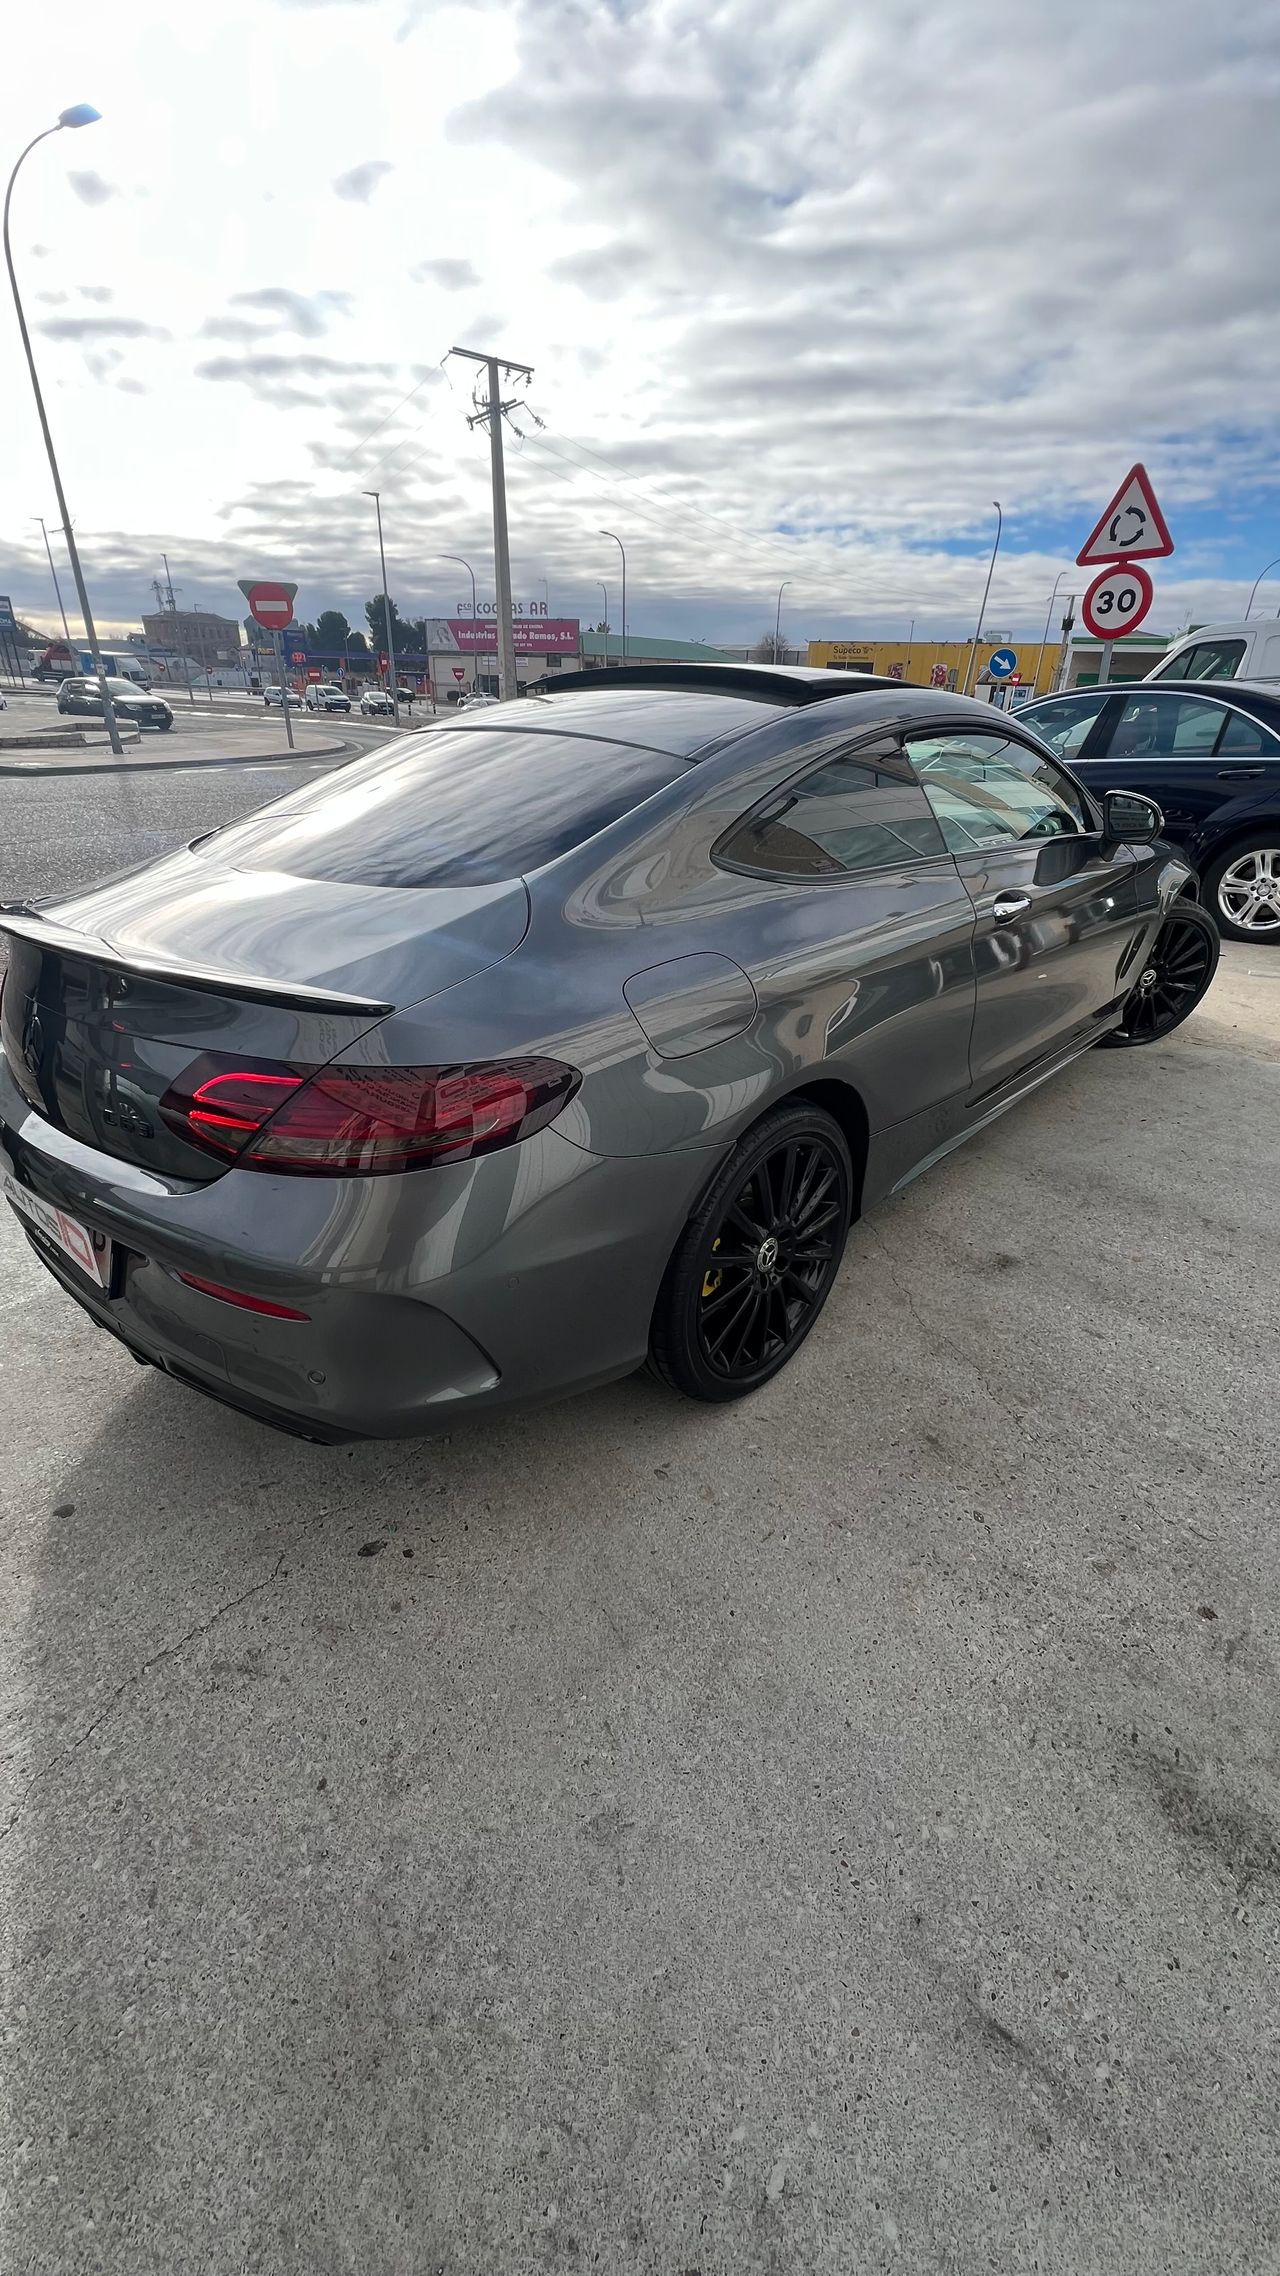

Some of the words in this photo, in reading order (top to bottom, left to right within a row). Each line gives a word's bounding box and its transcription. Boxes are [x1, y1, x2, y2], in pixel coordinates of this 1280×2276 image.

[1096, 588, 1136, 615] 30
[476, 602, 523, 614] COCAS
[530, 602, 548, 615] AR
[458, 631, 496, 639] Industrias
[529, 631, 558, 642] Ramos,
[560, 631, 574, 640] S.L.
[833, 645, 862, 655] Supeco
